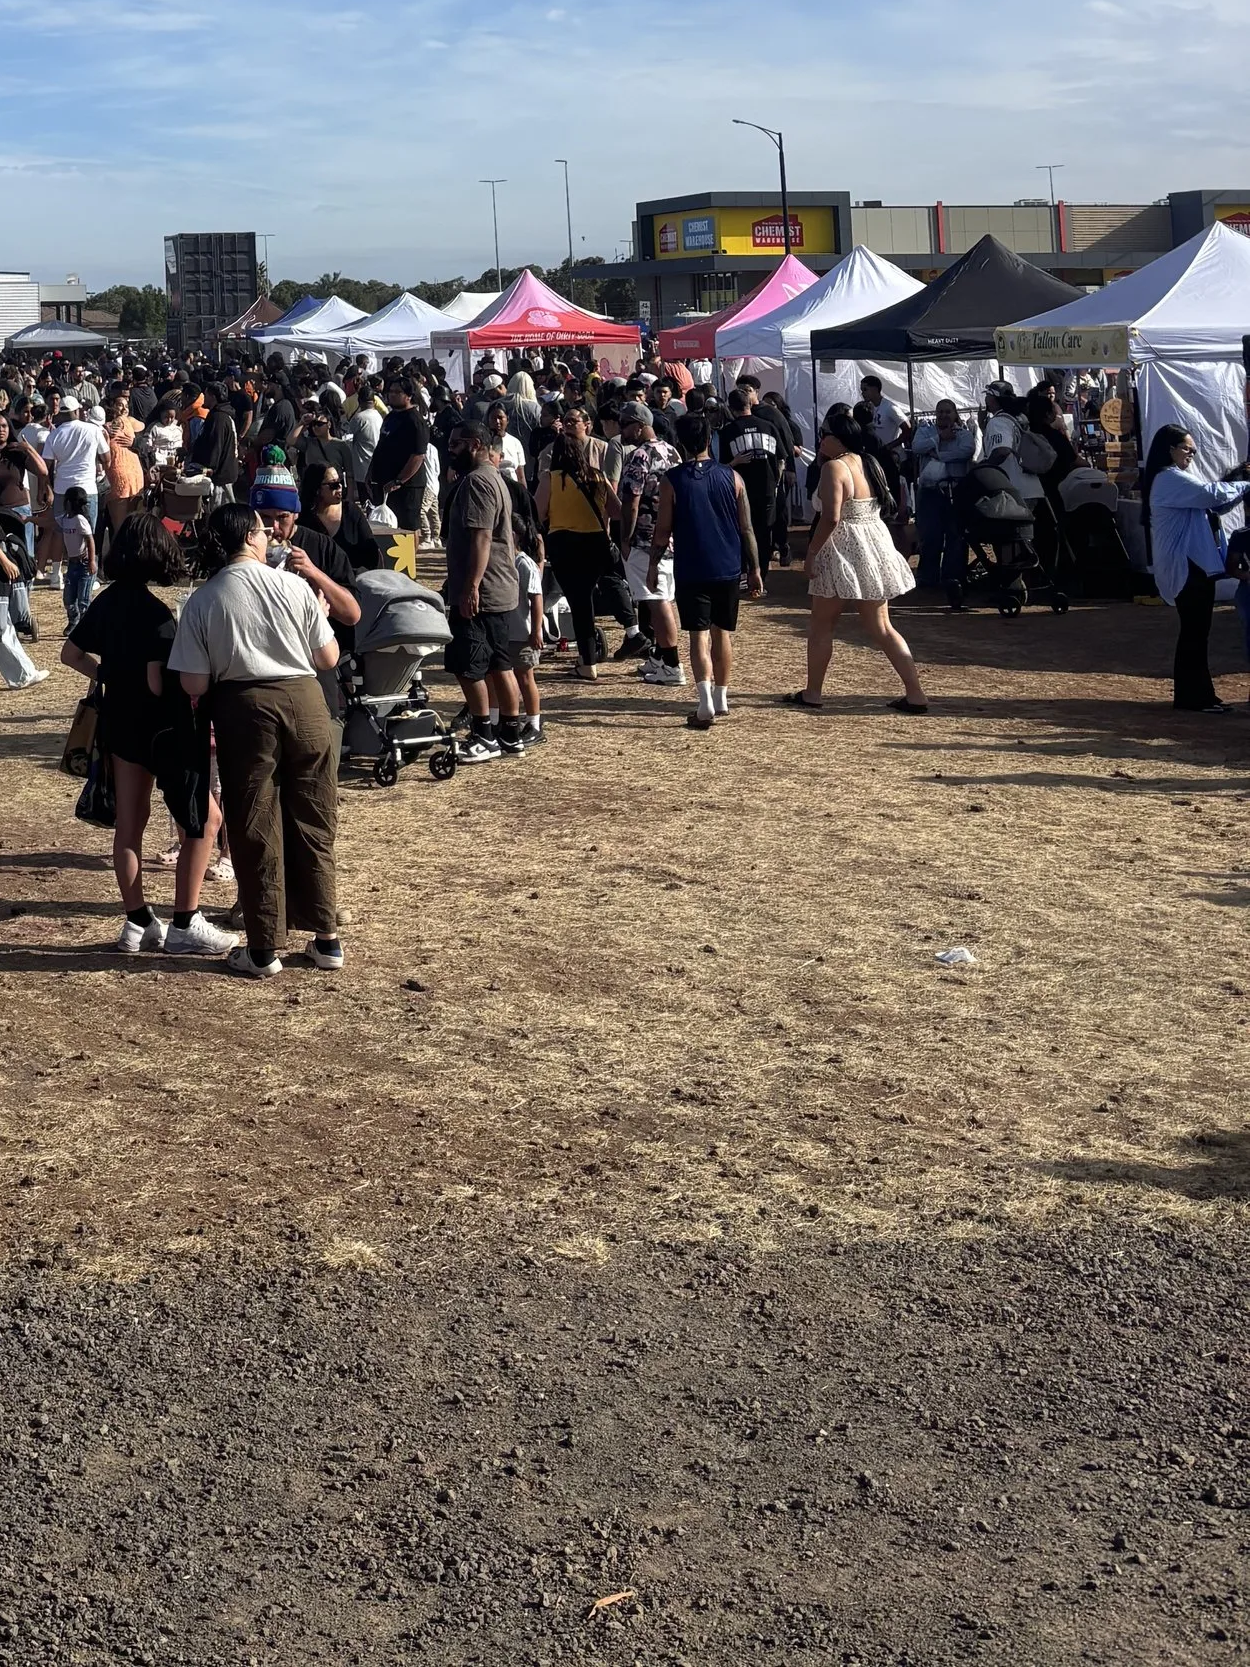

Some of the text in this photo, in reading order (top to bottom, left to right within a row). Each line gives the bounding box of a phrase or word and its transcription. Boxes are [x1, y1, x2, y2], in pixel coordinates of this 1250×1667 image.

[689, 220, 709, 233] CHEMIST
[754, 225, 801, 237] CHEMST
[510, 334, 524, 343] THE
[546, 332, 555, 341] OF
[1033, 331, 1082, 349] Tallow Care
